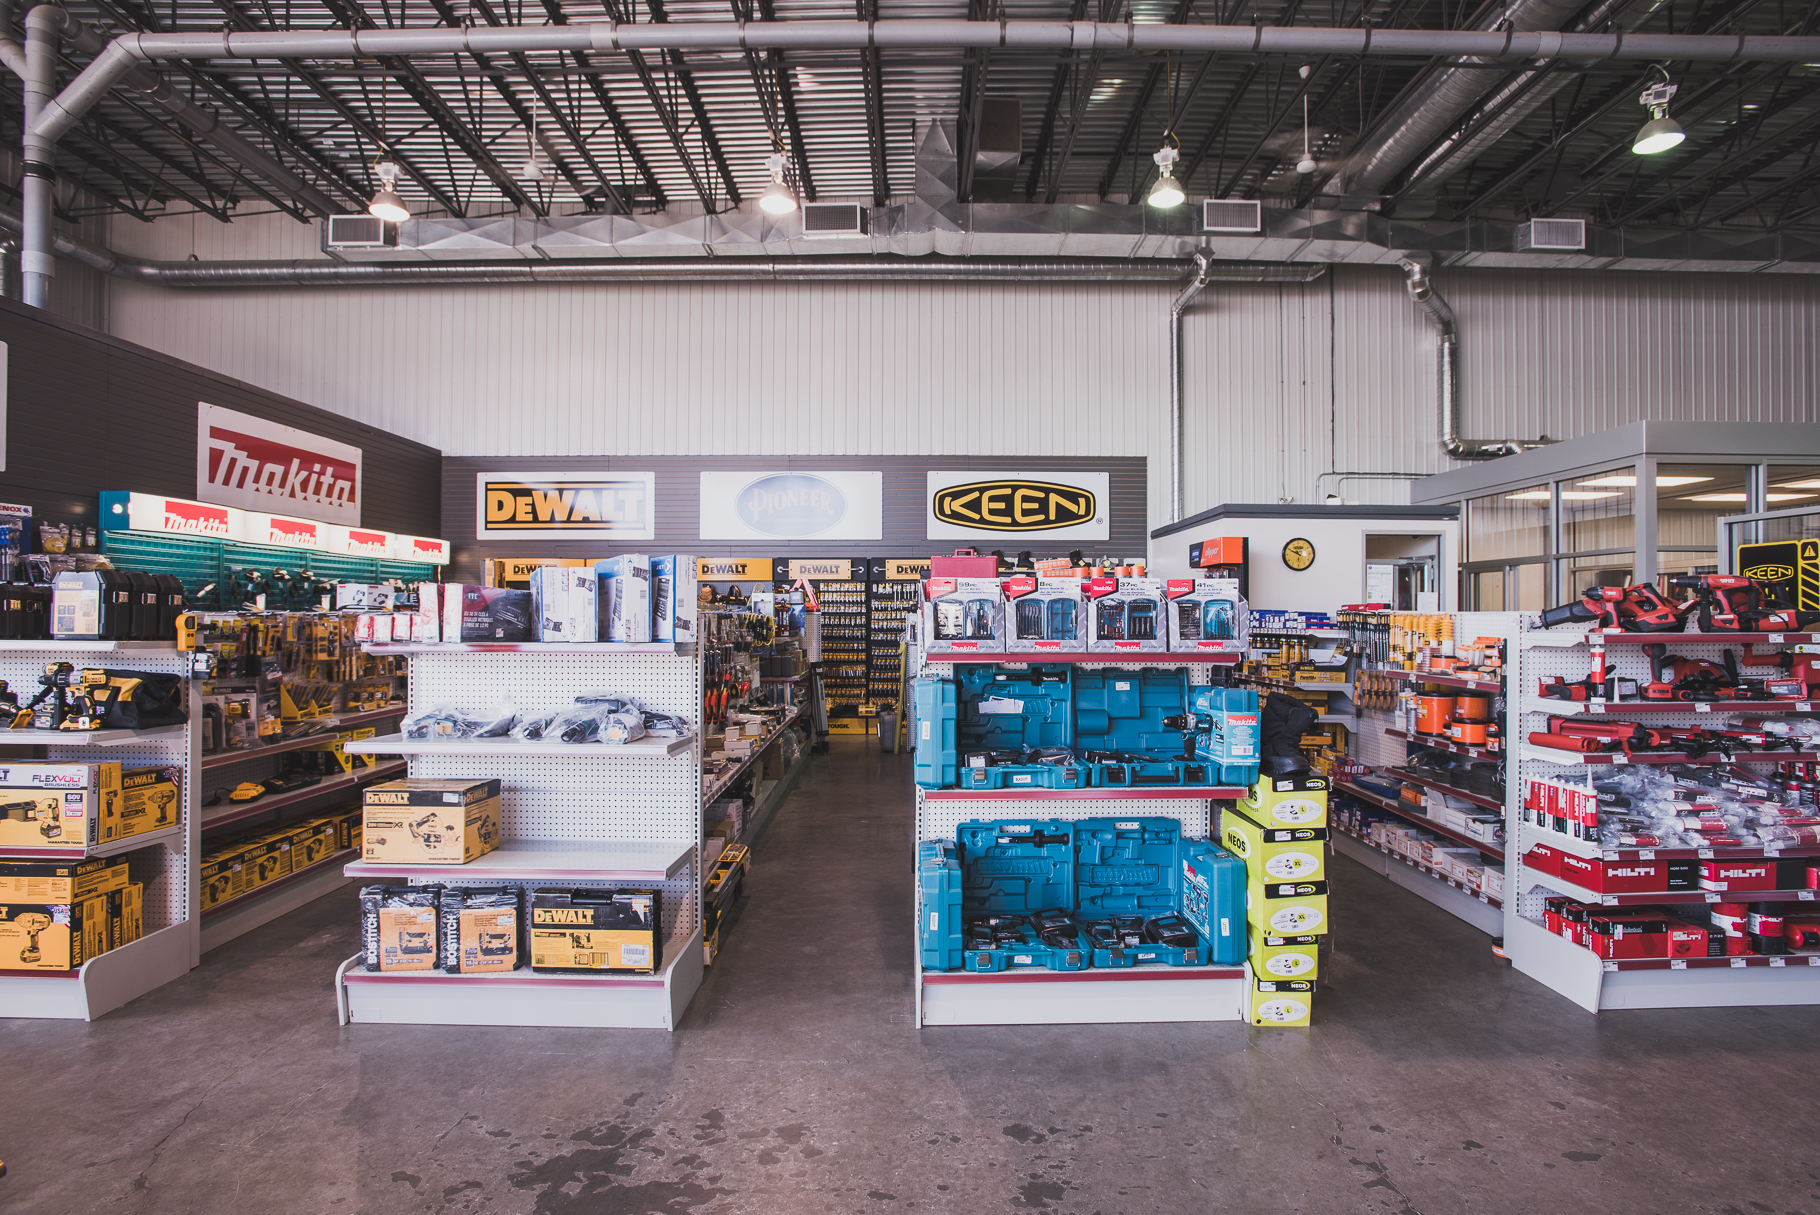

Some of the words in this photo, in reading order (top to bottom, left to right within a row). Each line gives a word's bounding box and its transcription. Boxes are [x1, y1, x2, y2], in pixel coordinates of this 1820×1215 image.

[208, 437, 352, 506] Makita
[748, 488, 834, 523] PIONEER
[943, 488, 1086, 523] KEEN
[165, 512, 227, 535] Makita
[1746, 567, 1791, 579] KEEN
[1228, 718, 1257, 726] Makita
[366, 793, 410, 803] DEWALT
[1227, 832, 1246, 852] NEOS
[200, 865, 219, 877] WALT
[1564, 856, 1591, 871] HILTI
[1607, 867, 1655, 877] HILTI
[1720, 868, 1766, 878] HILTI
[535, 909, 594, 923] DEWALT
[367, 913, 378, 964] BOSTITCH
[447, 915, 457, 966] BOSTITCH
